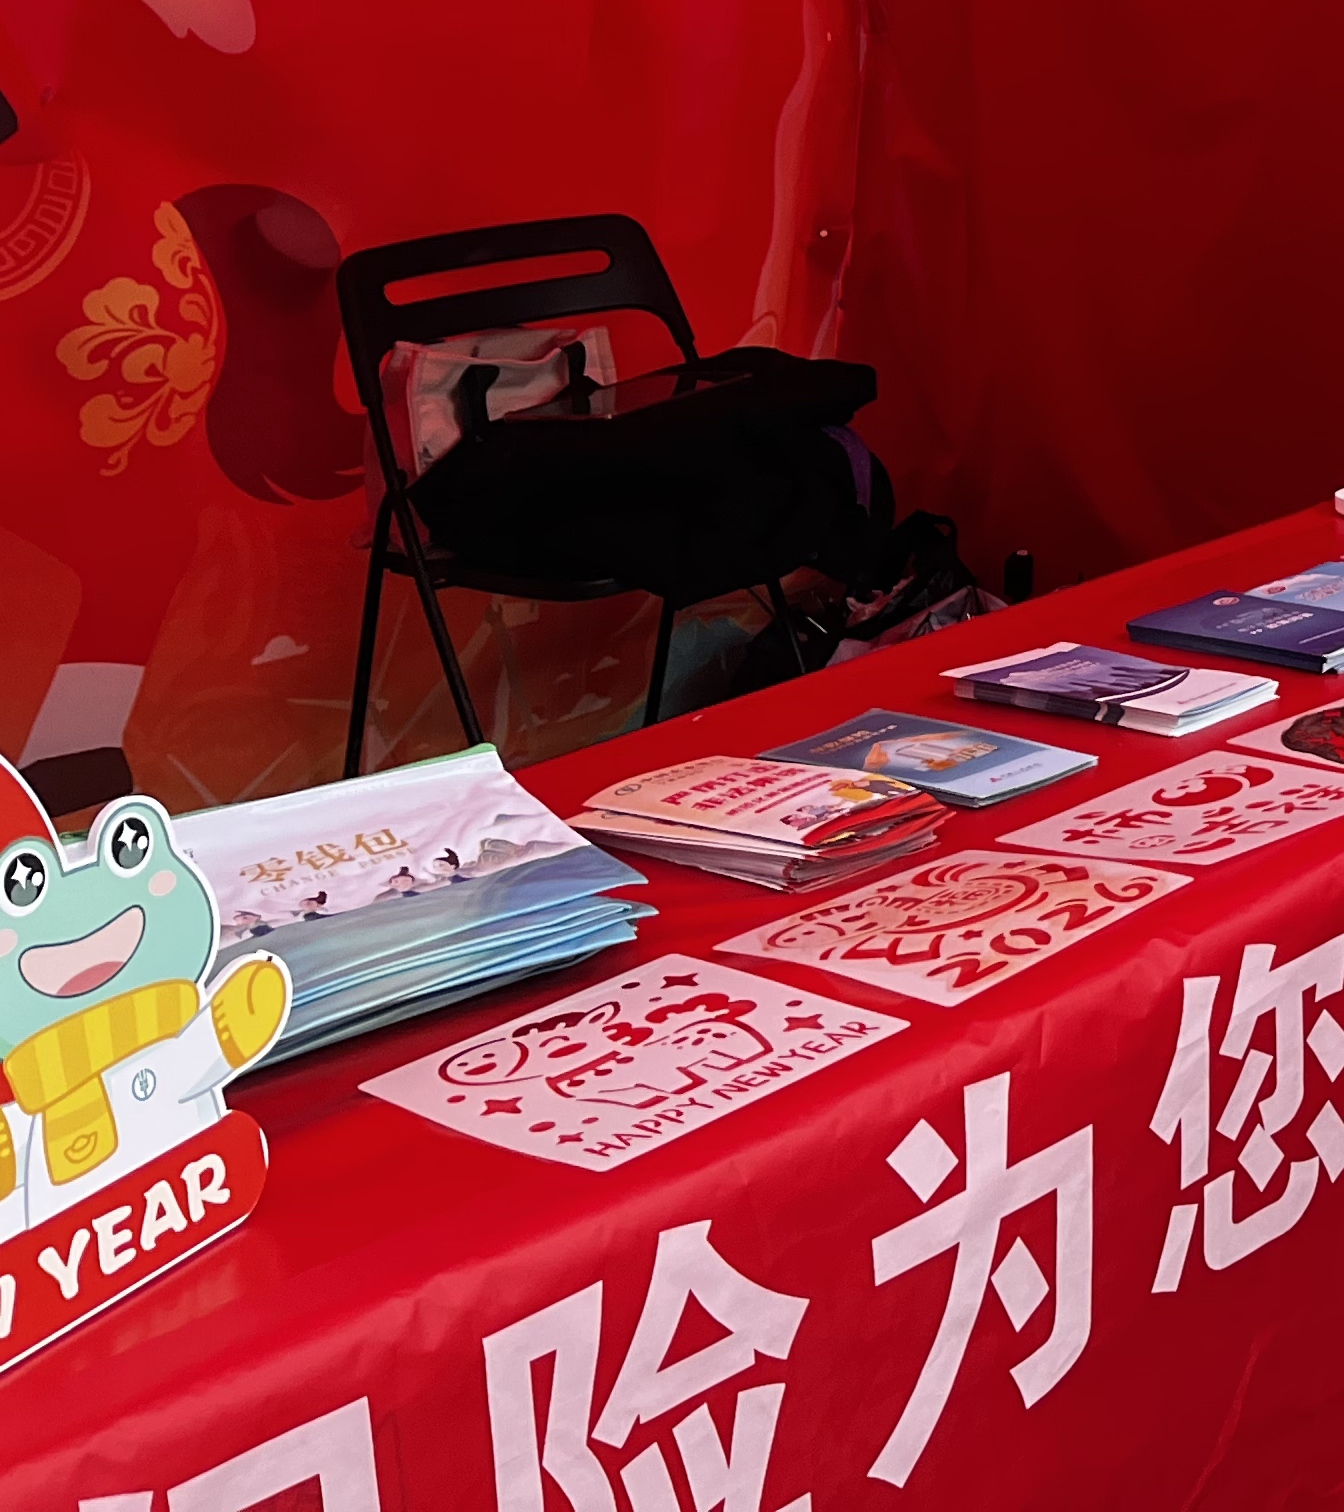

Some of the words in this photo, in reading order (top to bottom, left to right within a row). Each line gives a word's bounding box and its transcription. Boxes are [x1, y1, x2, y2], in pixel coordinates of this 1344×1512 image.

[239, 828, 408, 884] 零钱包
[260, 869, 340, 898] CHANGE
[927, 876, 1158, 989] 2026
[583, 1097, 714, 1157] HAPPY
[711, 1061, 793, 1100] NEW
[778, 1021, 880, 1061] YEAR
[38, 1152, 232, 1300] YEAR
